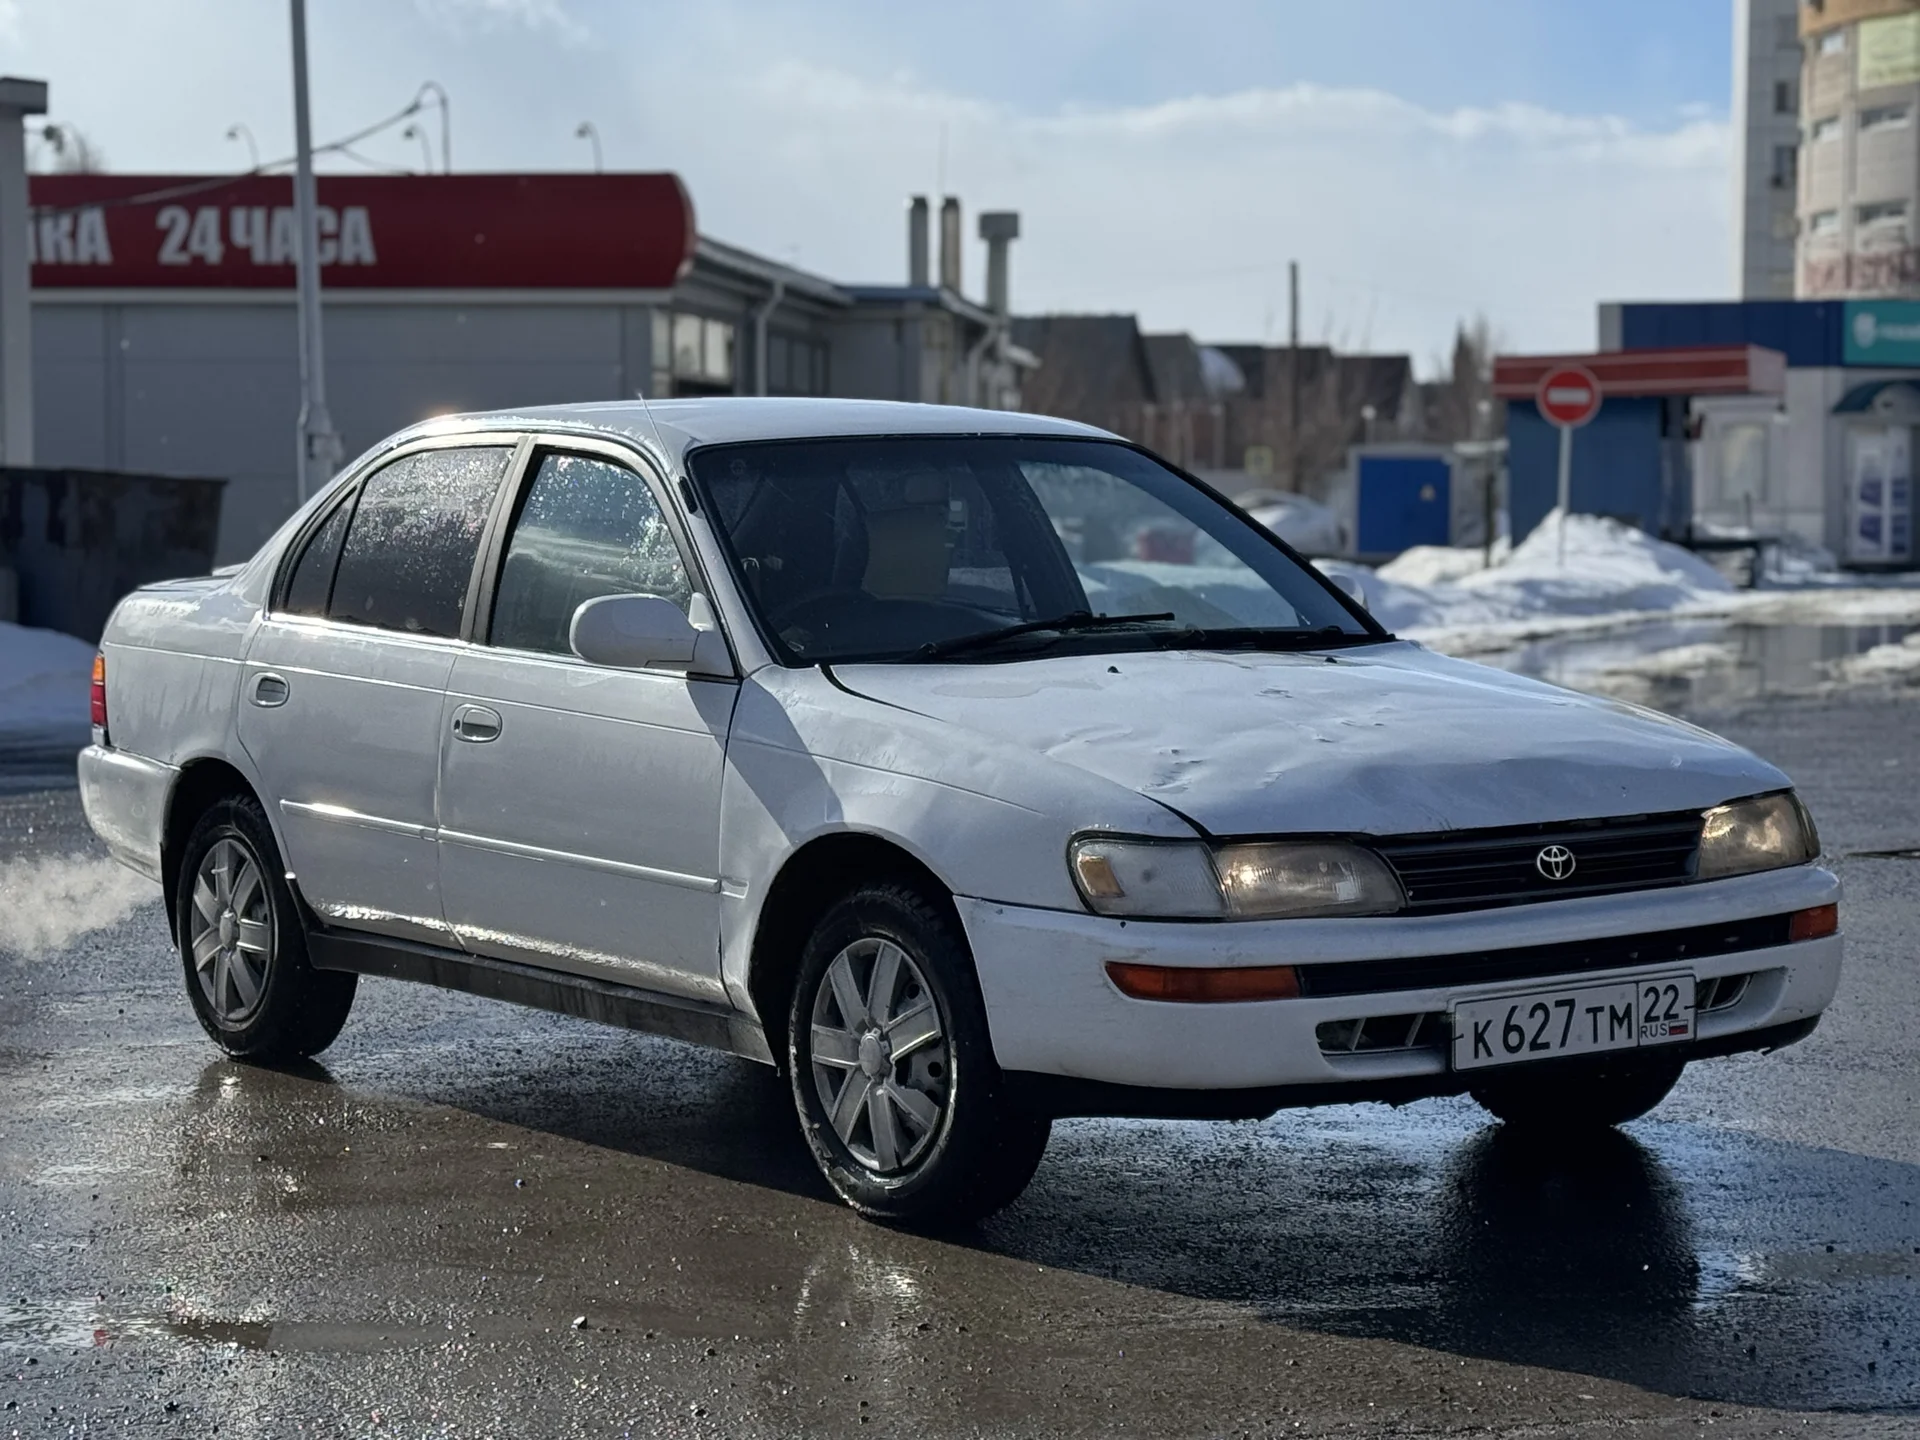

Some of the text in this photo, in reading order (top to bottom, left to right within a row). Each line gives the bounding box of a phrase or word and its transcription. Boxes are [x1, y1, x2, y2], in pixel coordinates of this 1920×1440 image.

[28, 205, 377, 265] КА 24 ЧАСА
[1643, 984, 1680, 1023] 22
[1640, 1024, 1668, 1039] RUS
